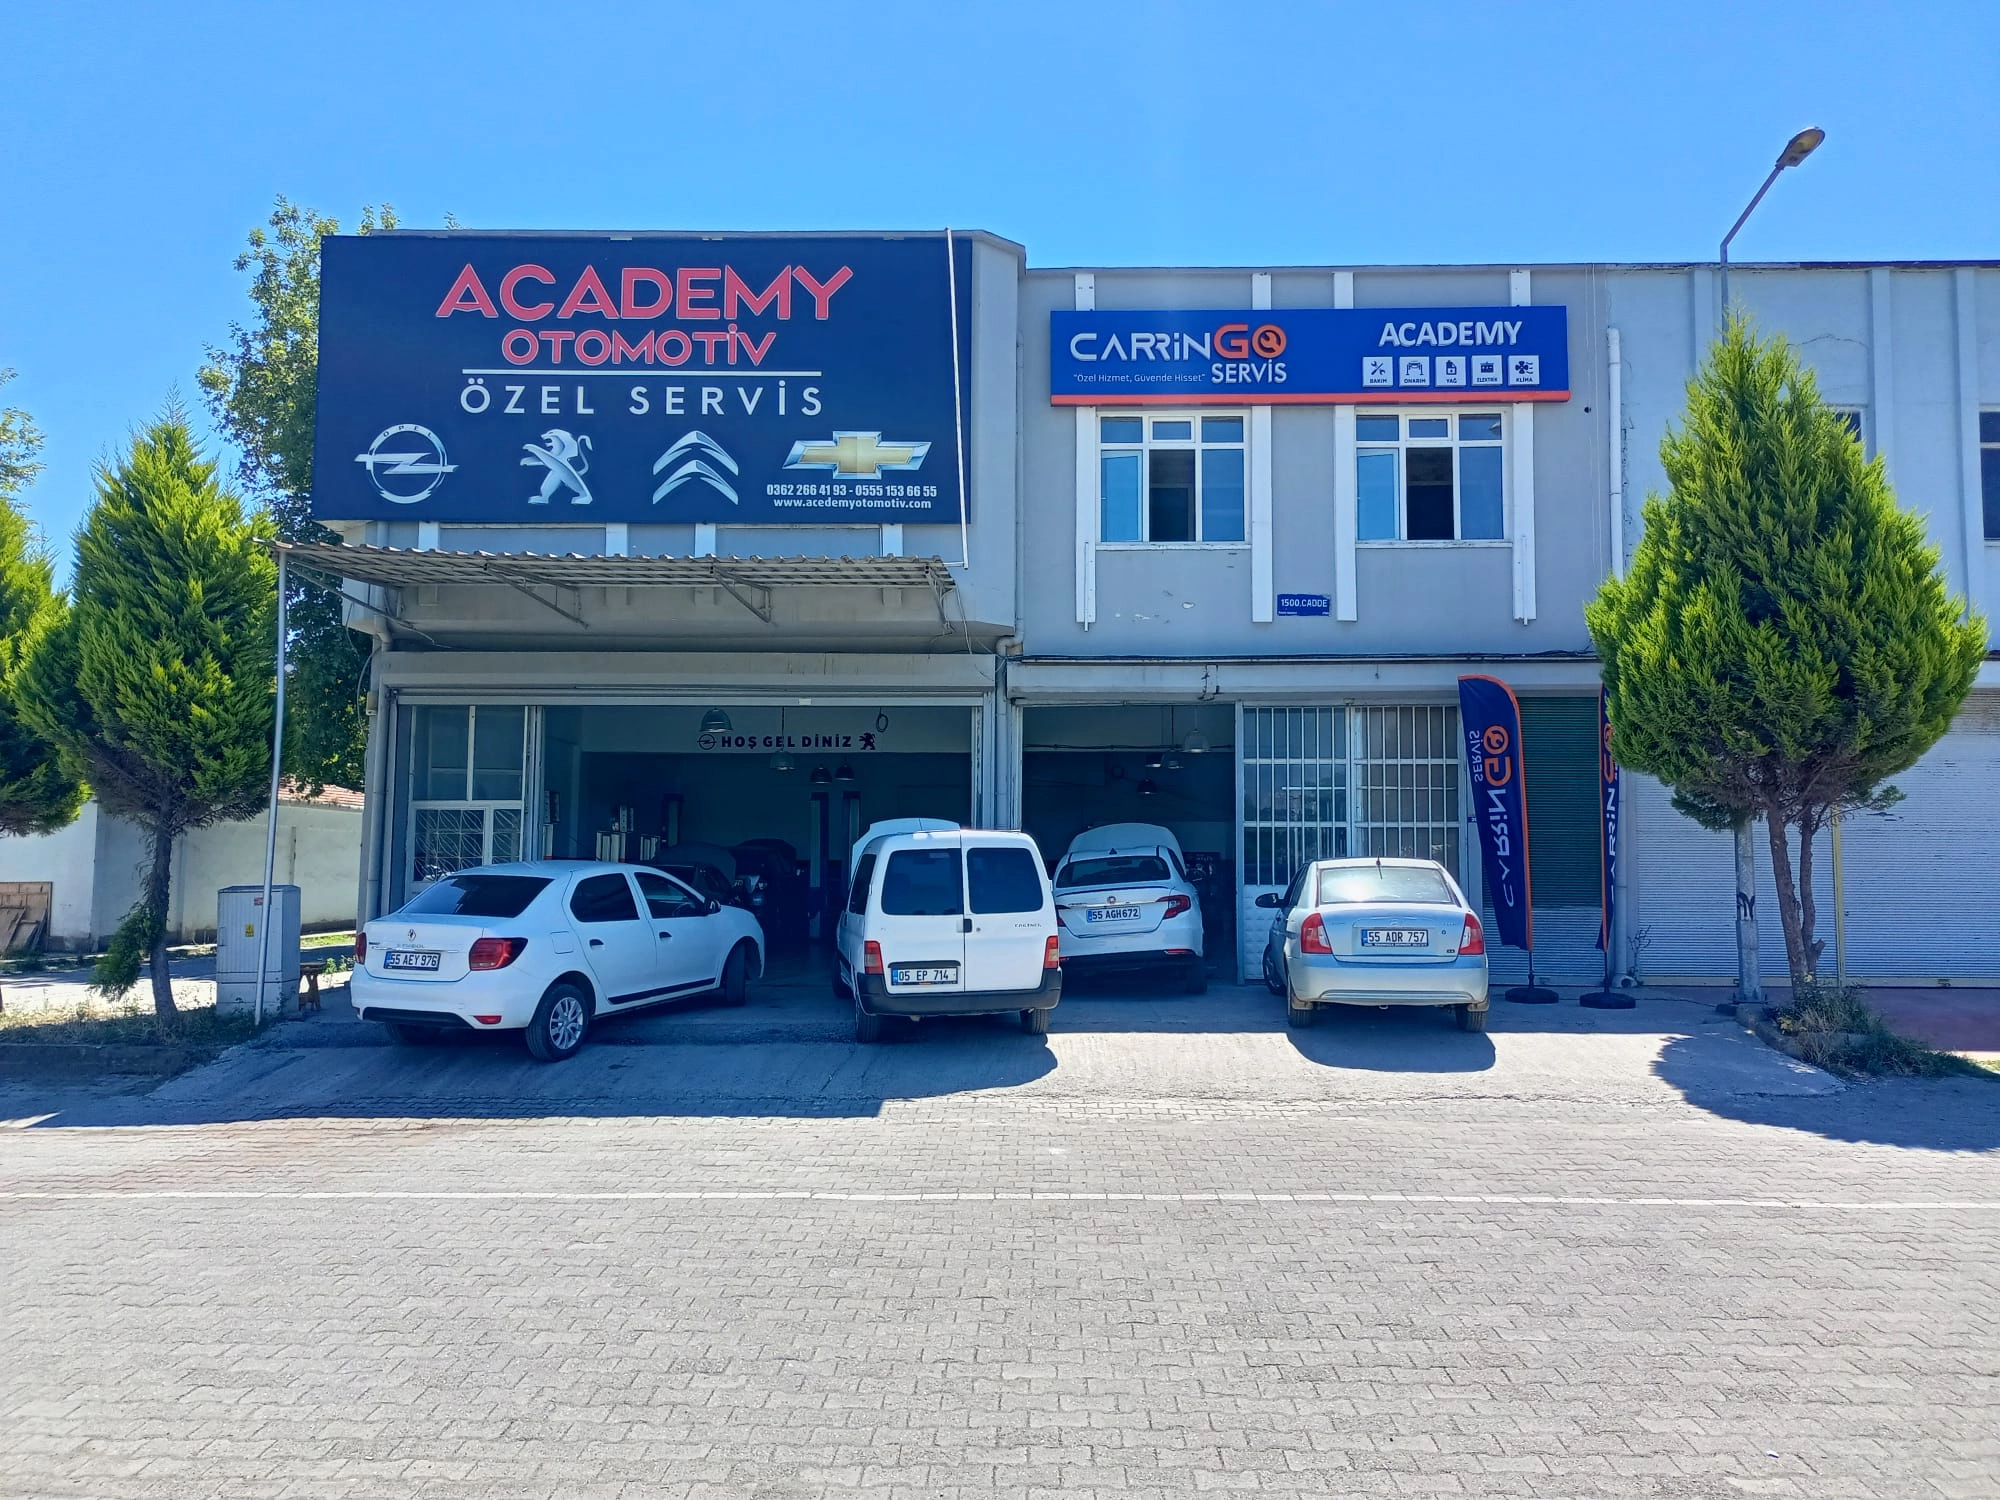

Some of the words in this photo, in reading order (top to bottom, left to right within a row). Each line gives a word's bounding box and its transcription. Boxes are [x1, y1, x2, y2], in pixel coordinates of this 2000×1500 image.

[435, 263, 854, 322] ACADEMY
[1378, 320, 1523, 347] ACADEMY
[501, 323, 777, 366] OTOMOTİV
[1098, 373, 1133, 383] Hizmet,
[1134, 373, 1172, 382] Güvende
[1211, 359, 1287, 384] SERVİS
[460, 377, 595, 414] ÖZEL
[628, 380, 823, 416] SERVİS
[383, 425, 432, 438] OPEL
[766, 484, 794, 496] 0362
[796, 484, 817, 496] 266
[819, 485, 831, 496] 41
[833, 485, 847, 496] 93
[855, 484, 883, 497] 0555
[885, 485, 904, 497] 153
[907, 485, 921, 497] 66
[923, 485, 937, 497] 55
[773, 497, 932, 510] www.acedemyotomotiv.com
[721, 736, 757, 749] HOŞ
[1092, 910, 1103, 920] 55
[1105, 909, 1121, 919] AGH
[1122, 908, 1139, 919] 672
[1368, 931, 1380, 942] 55
[1407, 931, 1425, 942] 757
[389, 953, 401, 965] 55
[402, 954, 420, 966] AEY
[420, 955, 438, 967] 976
[898, 970, 910, 981] 05
[916, 970, 928, 981] EP
[933, 969, 949, 981] 714
